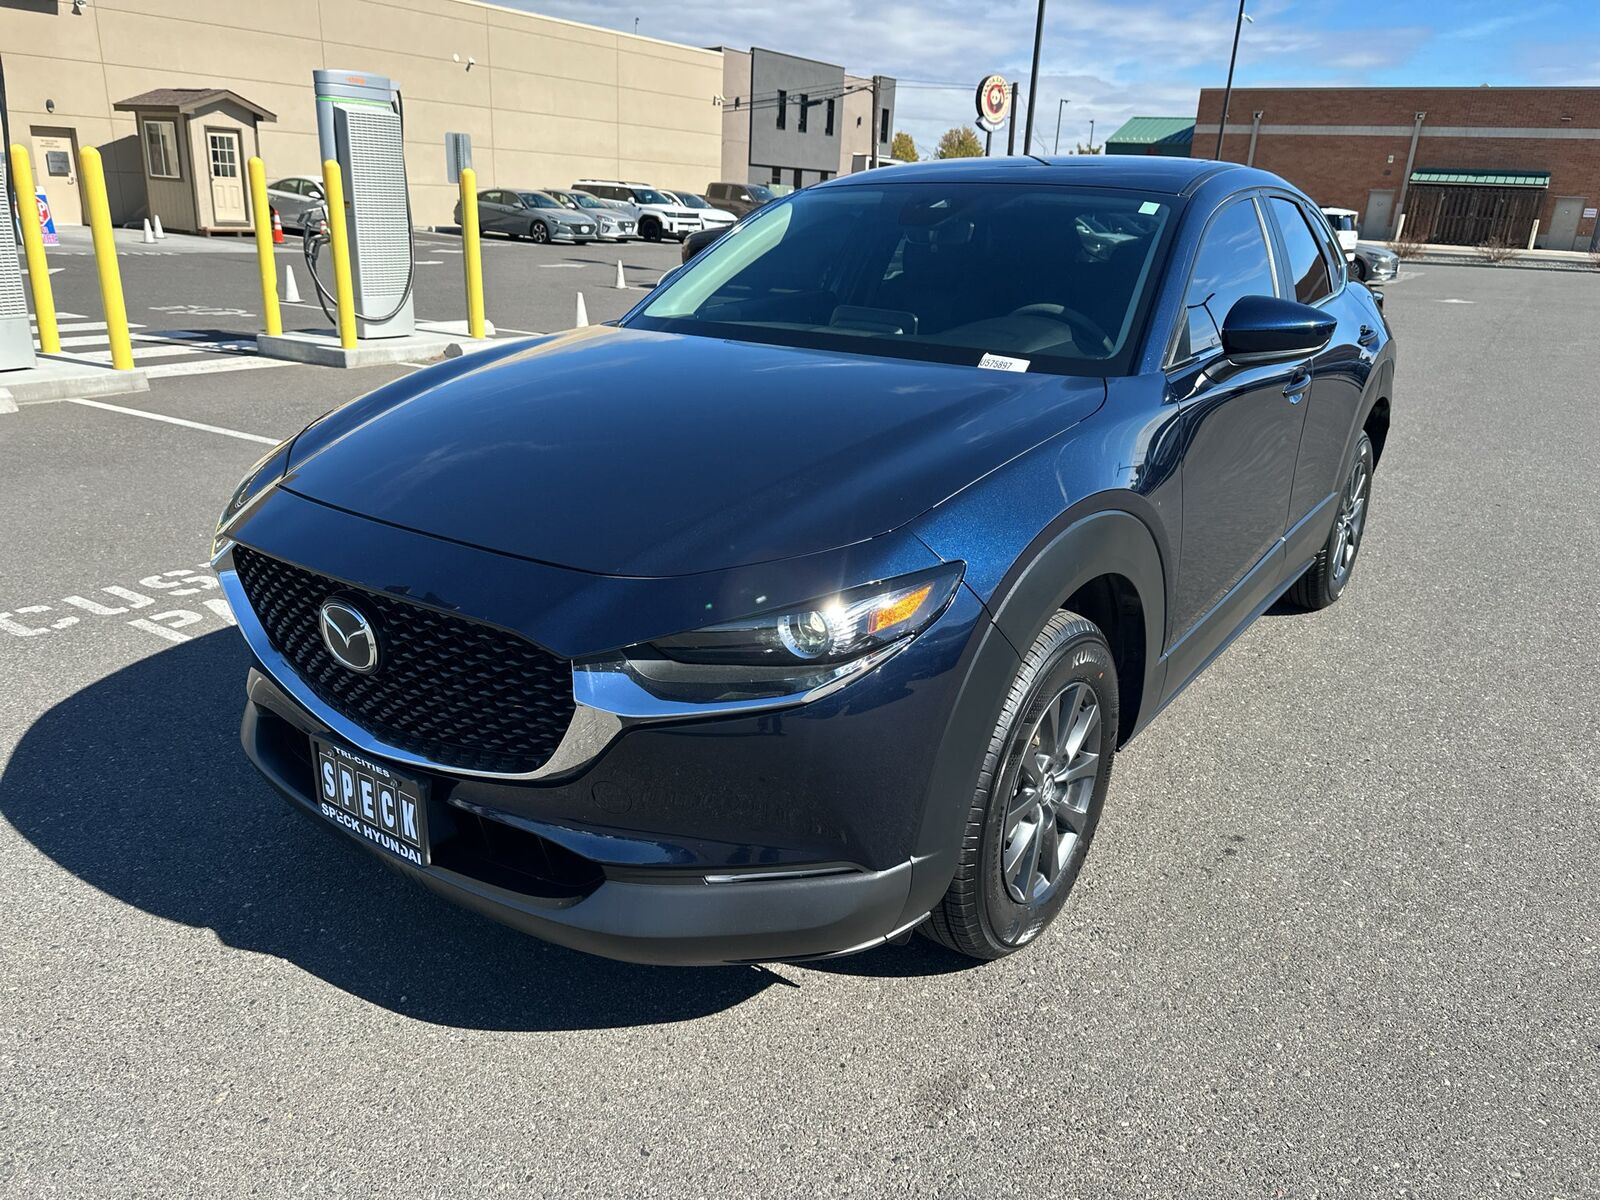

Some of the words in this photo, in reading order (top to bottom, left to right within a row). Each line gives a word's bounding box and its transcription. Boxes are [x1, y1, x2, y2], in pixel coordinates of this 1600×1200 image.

[0, 562, 220, 637] CUS
[333, 746, 390, 778] TRI-CITIES
[321, 803, 361, 833] SPECK
[363, 824, 422, 865] HYUNDAI
[323, 761, 417, 840] SPECK
